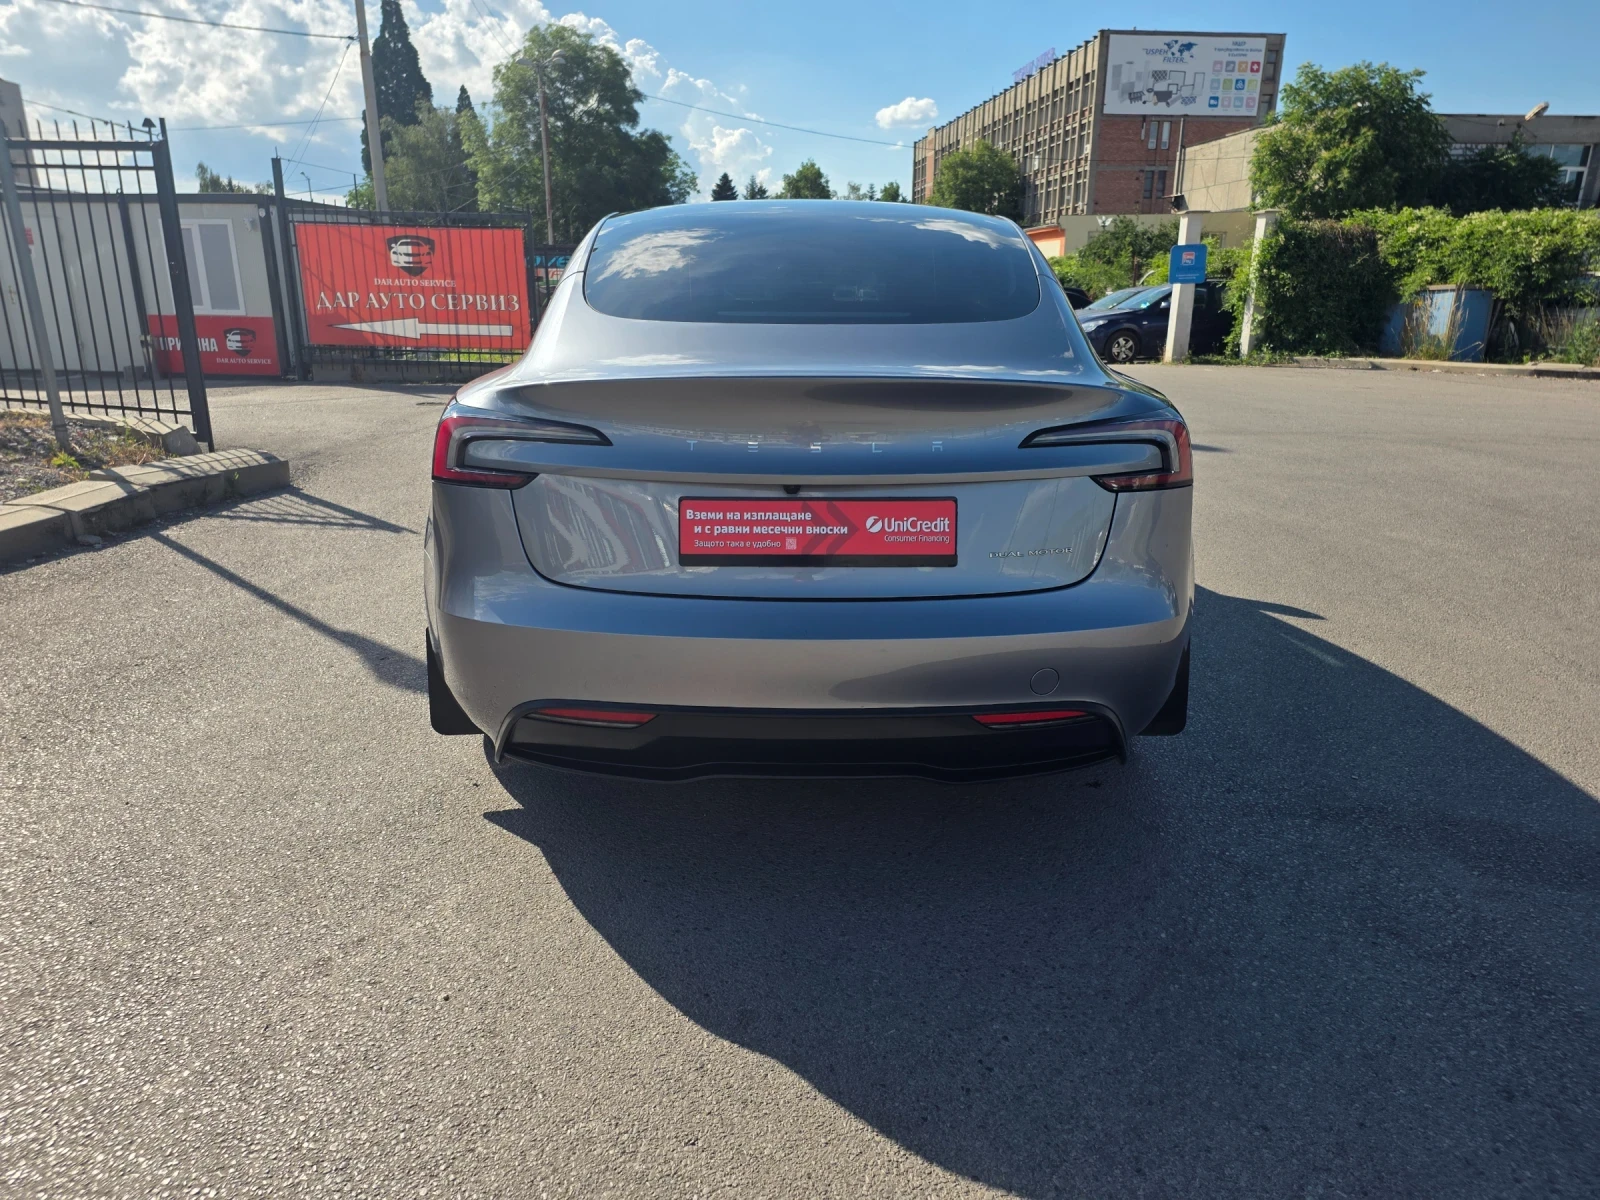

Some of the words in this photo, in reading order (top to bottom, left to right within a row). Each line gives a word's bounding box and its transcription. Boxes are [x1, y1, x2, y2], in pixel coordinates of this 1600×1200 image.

[1145, 48, 1168, 56] USPEH
[1162, 56, 1185, 64] FILTER
[374, 278, 392, 286] DAR
[394, 279, 419, 287] AUTO
[420, 279, 457, 288] SERVICE
[317, 291, 360, 311] ДАР
[366, 292, 425, 310] АУТО
[431, 293, 520, 312] СЕРВИЗ
[686, 440, 943, 453] TESLA
[686, 509, 724, 520] Вземи
[726, 511, 741, 520] на
[743, 511, 812, 522] изплащане
[884, 516, 950, 532] UniCredit
[694, 525, 702, 534] и
[704, 525, 712, 533] с
[714, 525, 750, 536] равни
[752, 526, 803, 534] месечни
[805, 525, 848, 535] вноски
[694, 539, 725, 549] Защото
[752, 540, 781, 549] удобно
[884, 535, 917, 543] Consumer
[918, 535, 950, 544] Financing
[989, 551, 1025, 559] DUAL
[1028, 546, 1073, 557] MOTOR
